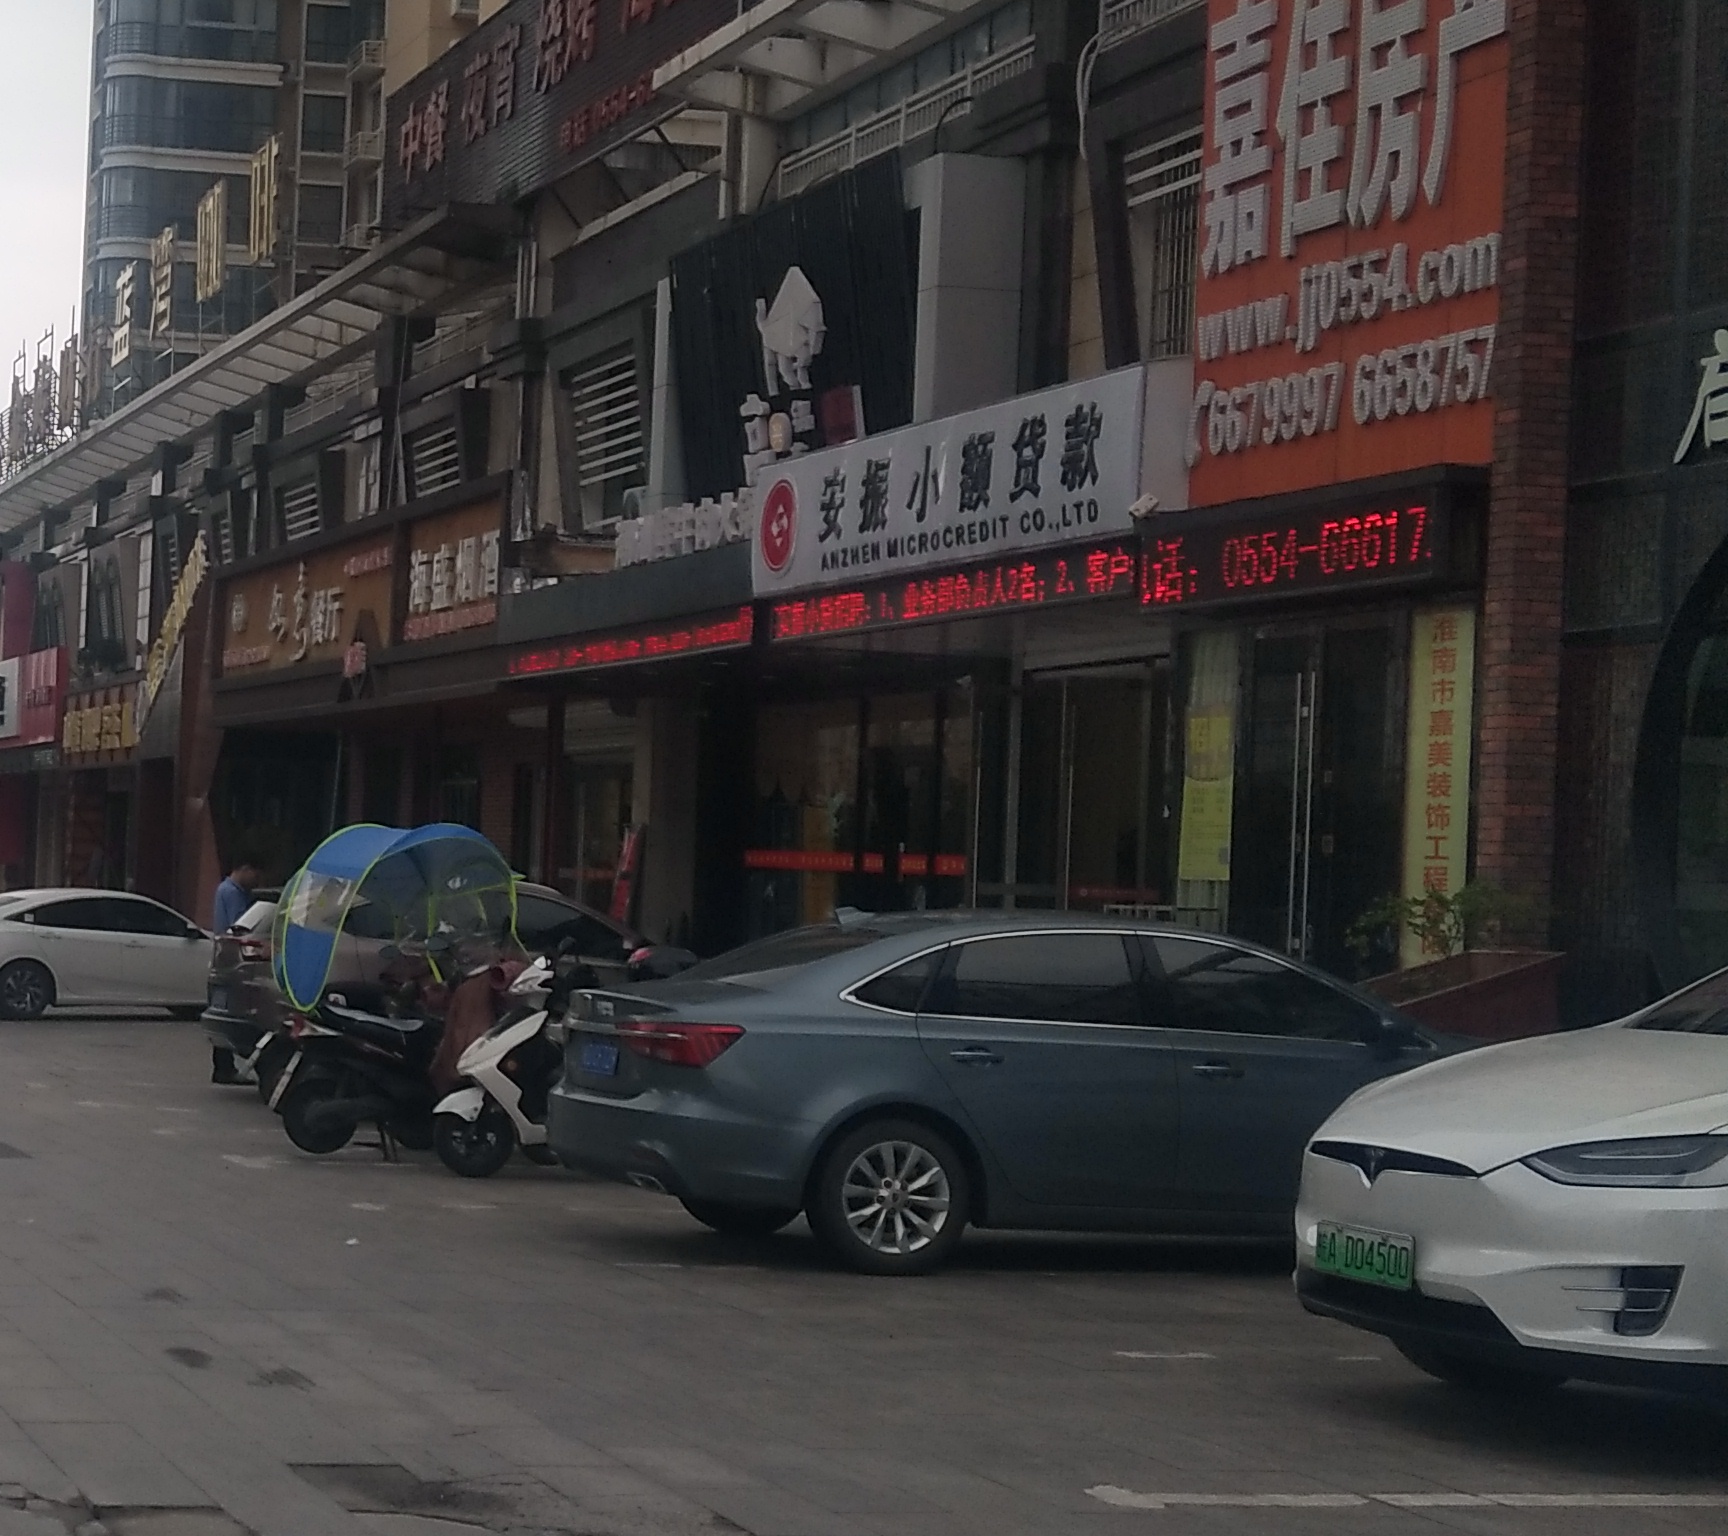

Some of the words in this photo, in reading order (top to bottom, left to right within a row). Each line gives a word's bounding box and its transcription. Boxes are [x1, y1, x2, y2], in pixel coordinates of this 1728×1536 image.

[399, 80, 450, 185] 中餐
[1197, 232, 1502, 361] www.jj0554.com
[1207, 361, 1344, 457] 6679997
[1353, 324, 1498, 426] 6658757
[818, 401, 1104, 543] 安振小额贷款
[820, 543, 881, 572] ANZHEN
[886, 514, 1009, 560] MICROCREDIT
